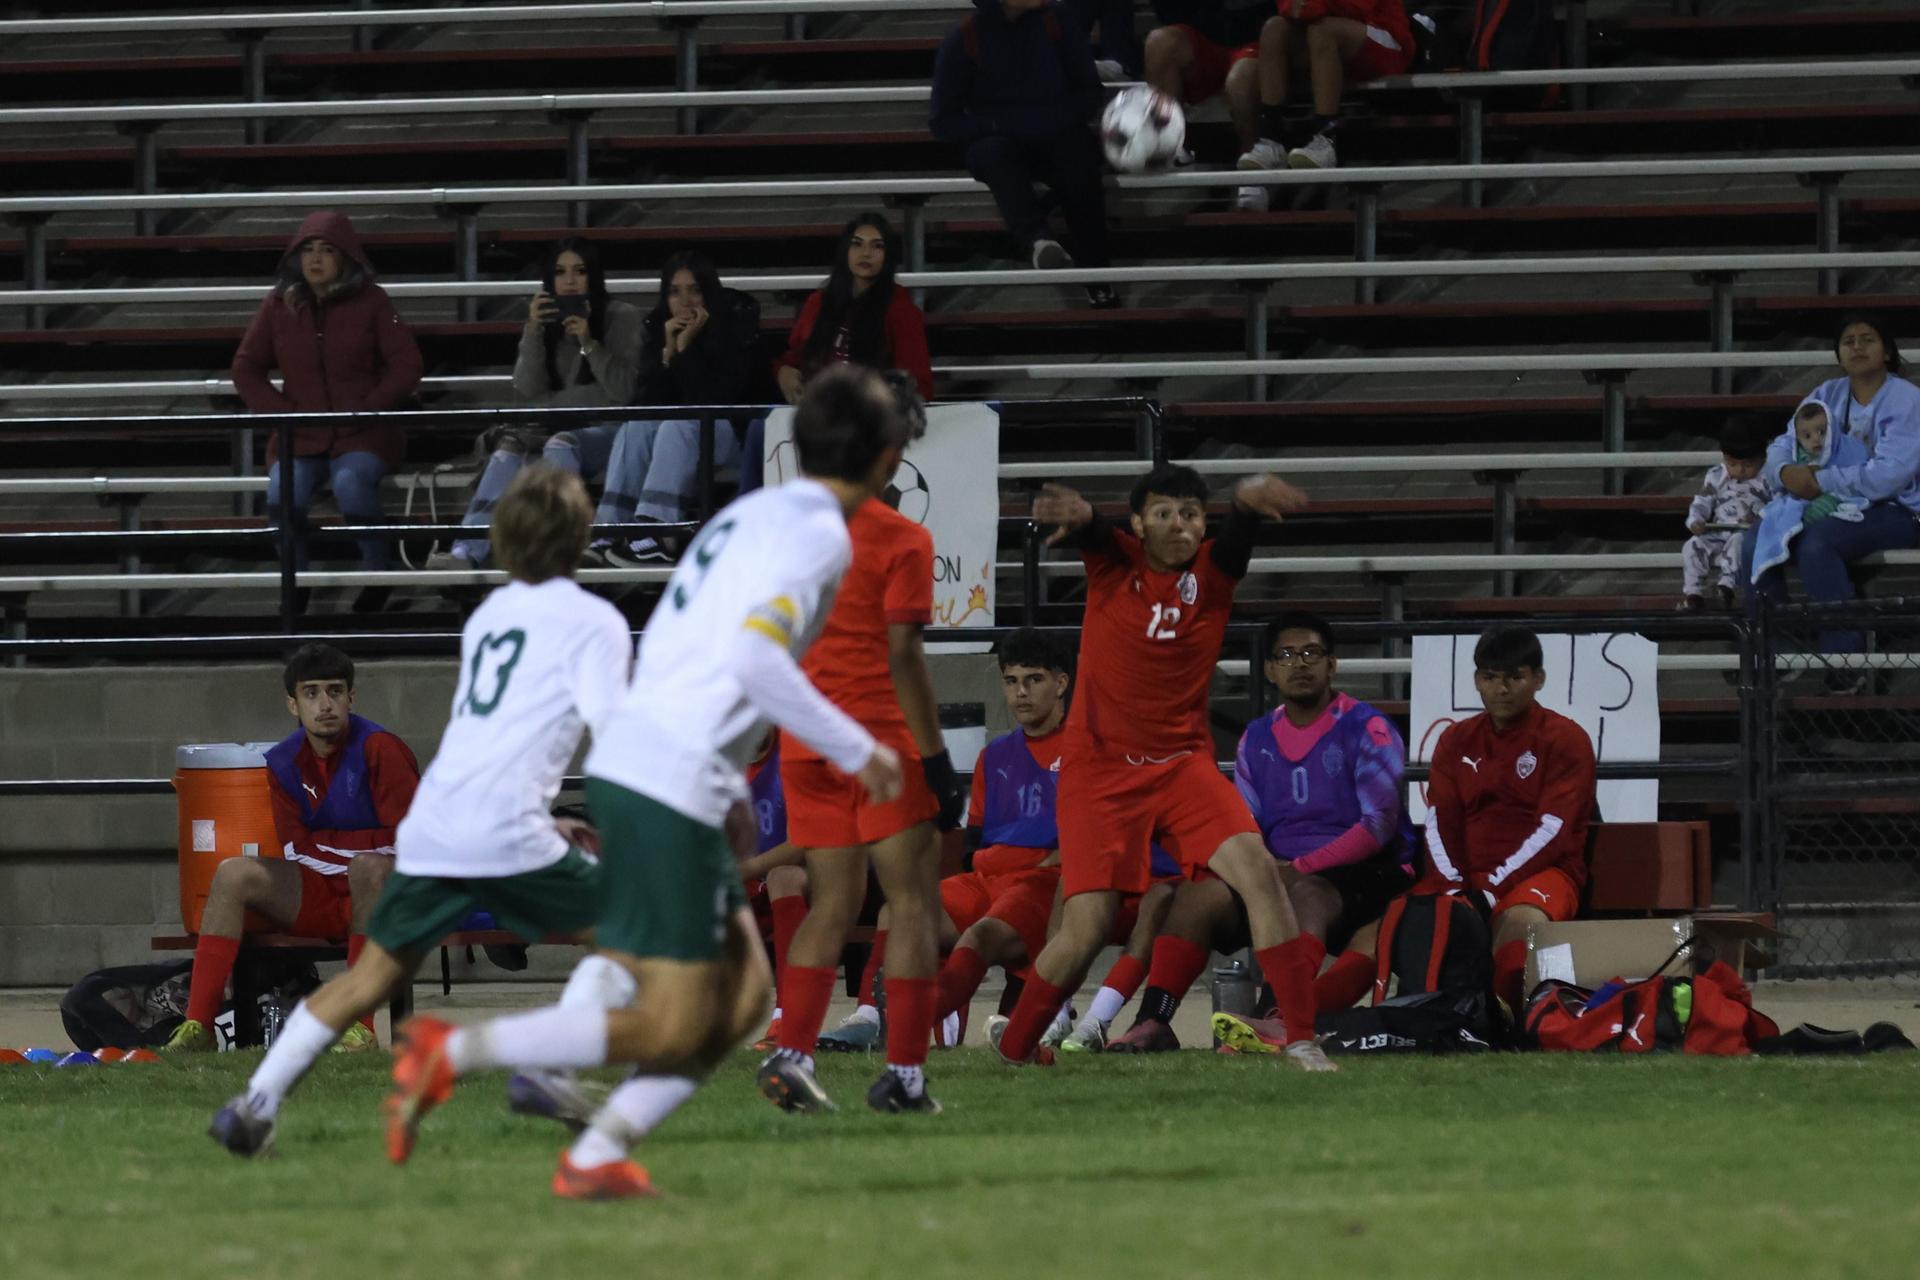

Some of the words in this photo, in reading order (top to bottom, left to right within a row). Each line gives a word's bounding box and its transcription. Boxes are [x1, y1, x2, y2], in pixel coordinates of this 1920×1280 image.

[1146, 602, 1181, 639] 12
[458, 627, 527, 718] 13
[1452, 632, 1634, 711] LTS
[1017, 783, 1043, 818] 16
